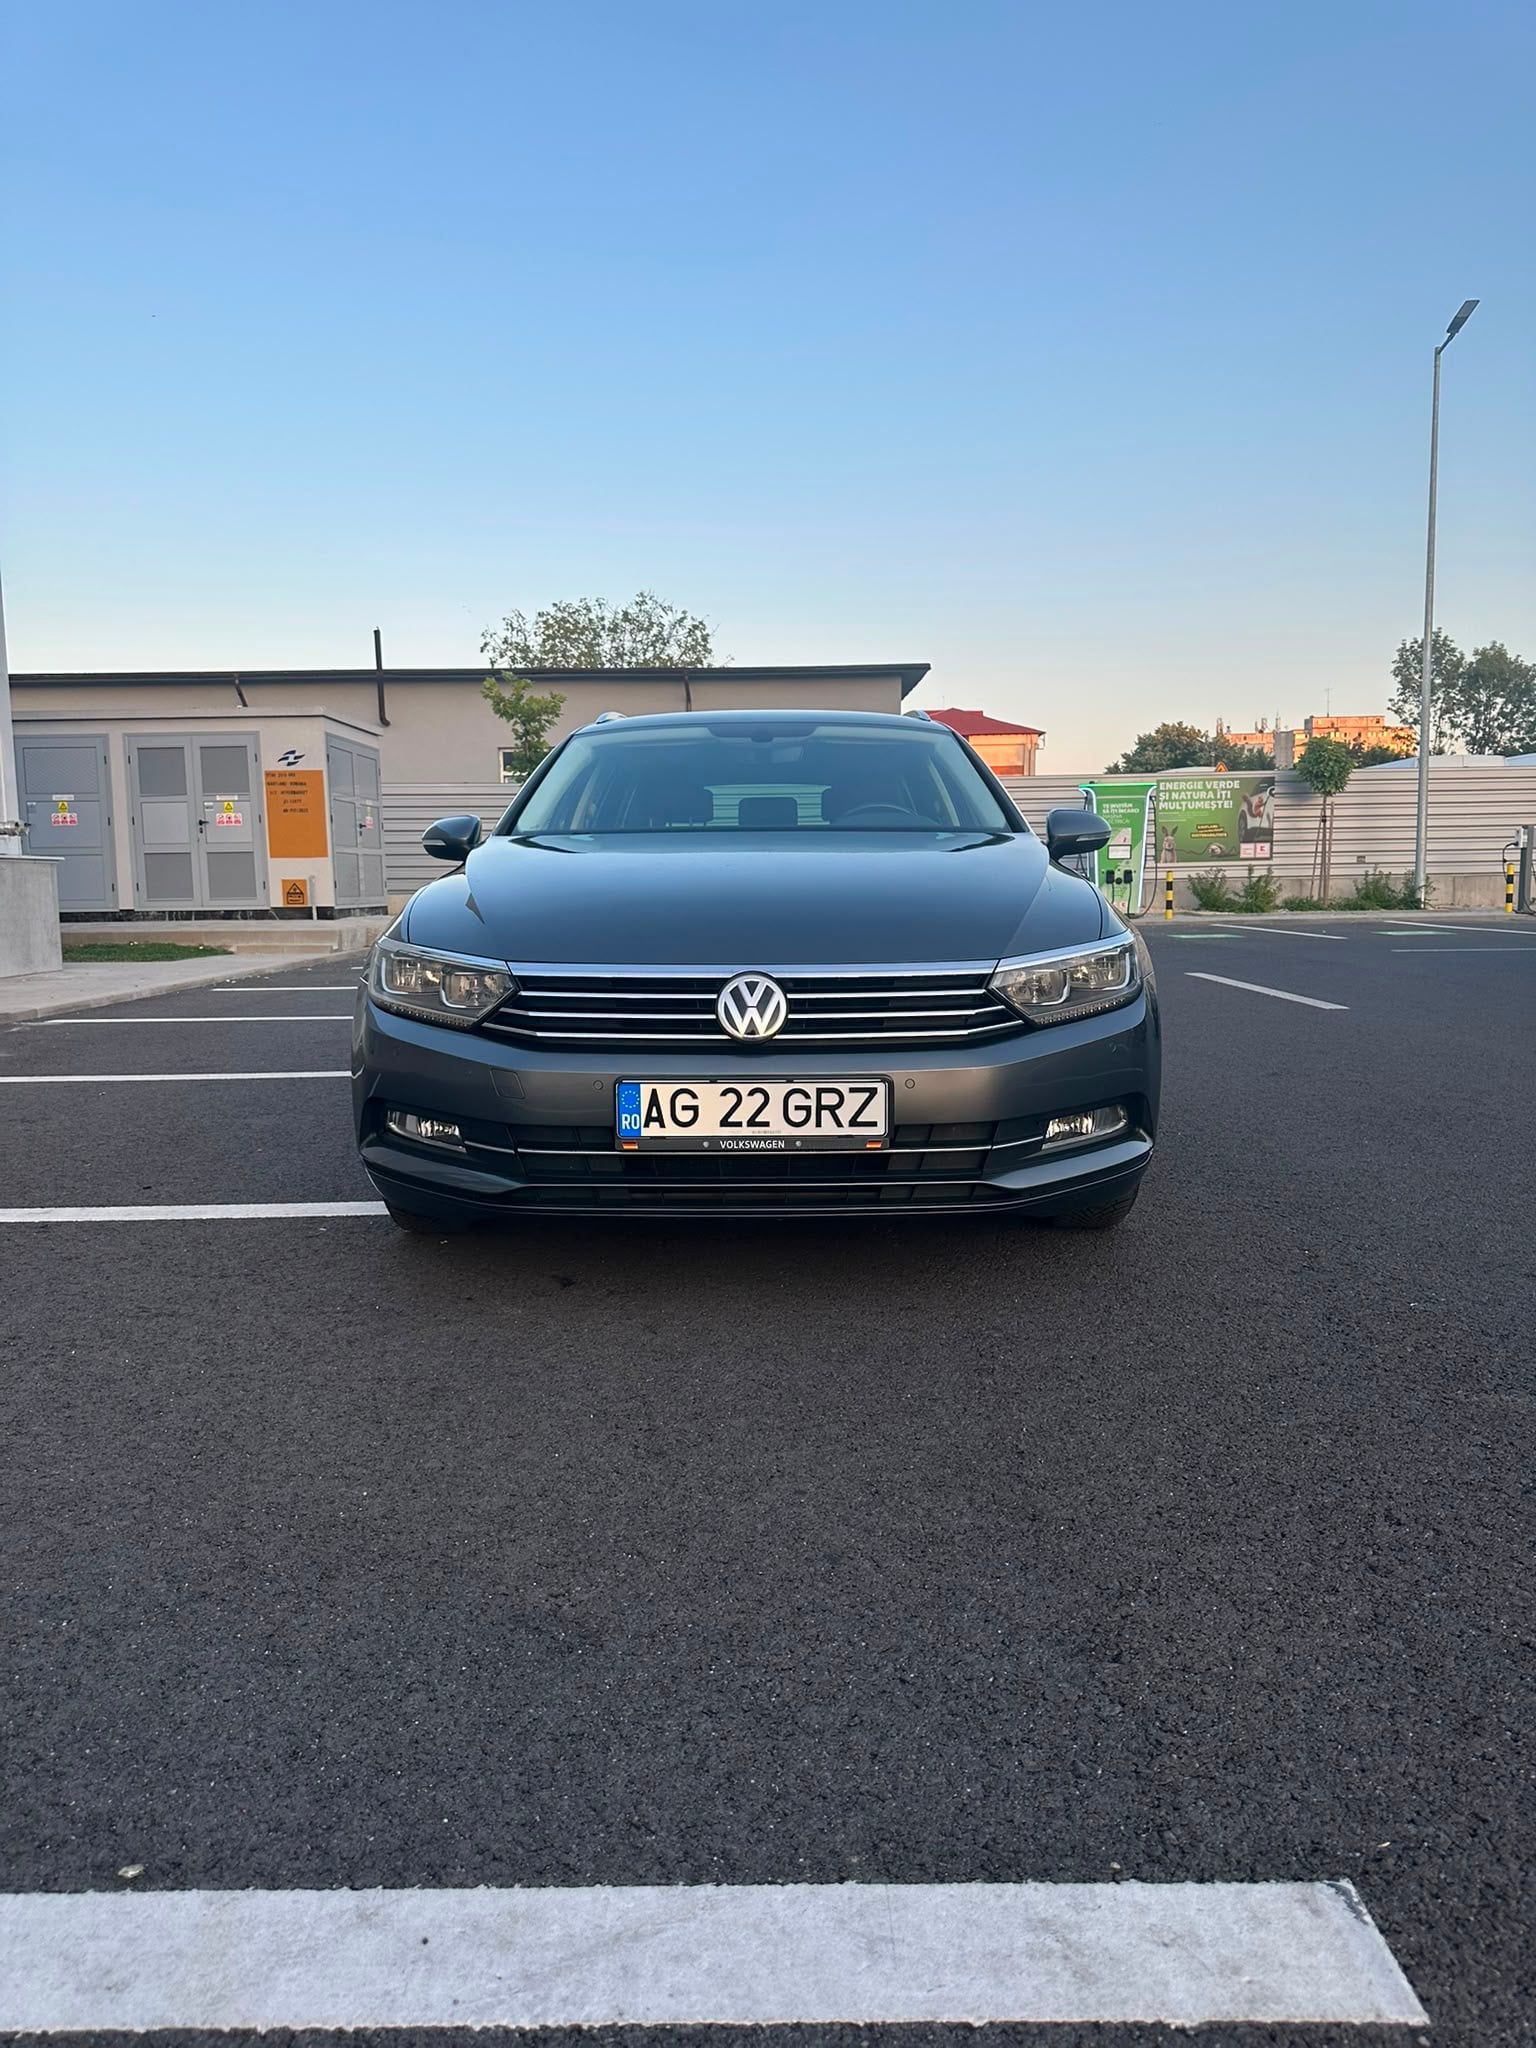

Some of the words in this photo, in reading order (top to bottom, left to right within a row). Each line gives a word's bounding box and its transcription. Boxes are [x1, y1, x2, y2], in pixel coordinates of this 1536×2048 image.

[1159, 781, 1204, 791] ENERGIE
[1205, 780, 1240, 789] VERDE
[1171, 790, 1215, 800] NATURA
[643, 1087, 700, 1129] AG
[719, 1086, 771, 1128] 22
[782, 1086, 878, 1128] GRZ
[621, 1113, 640, 1130] RO
[719, 1139, 785, 1149] VOLKSWAGEN
